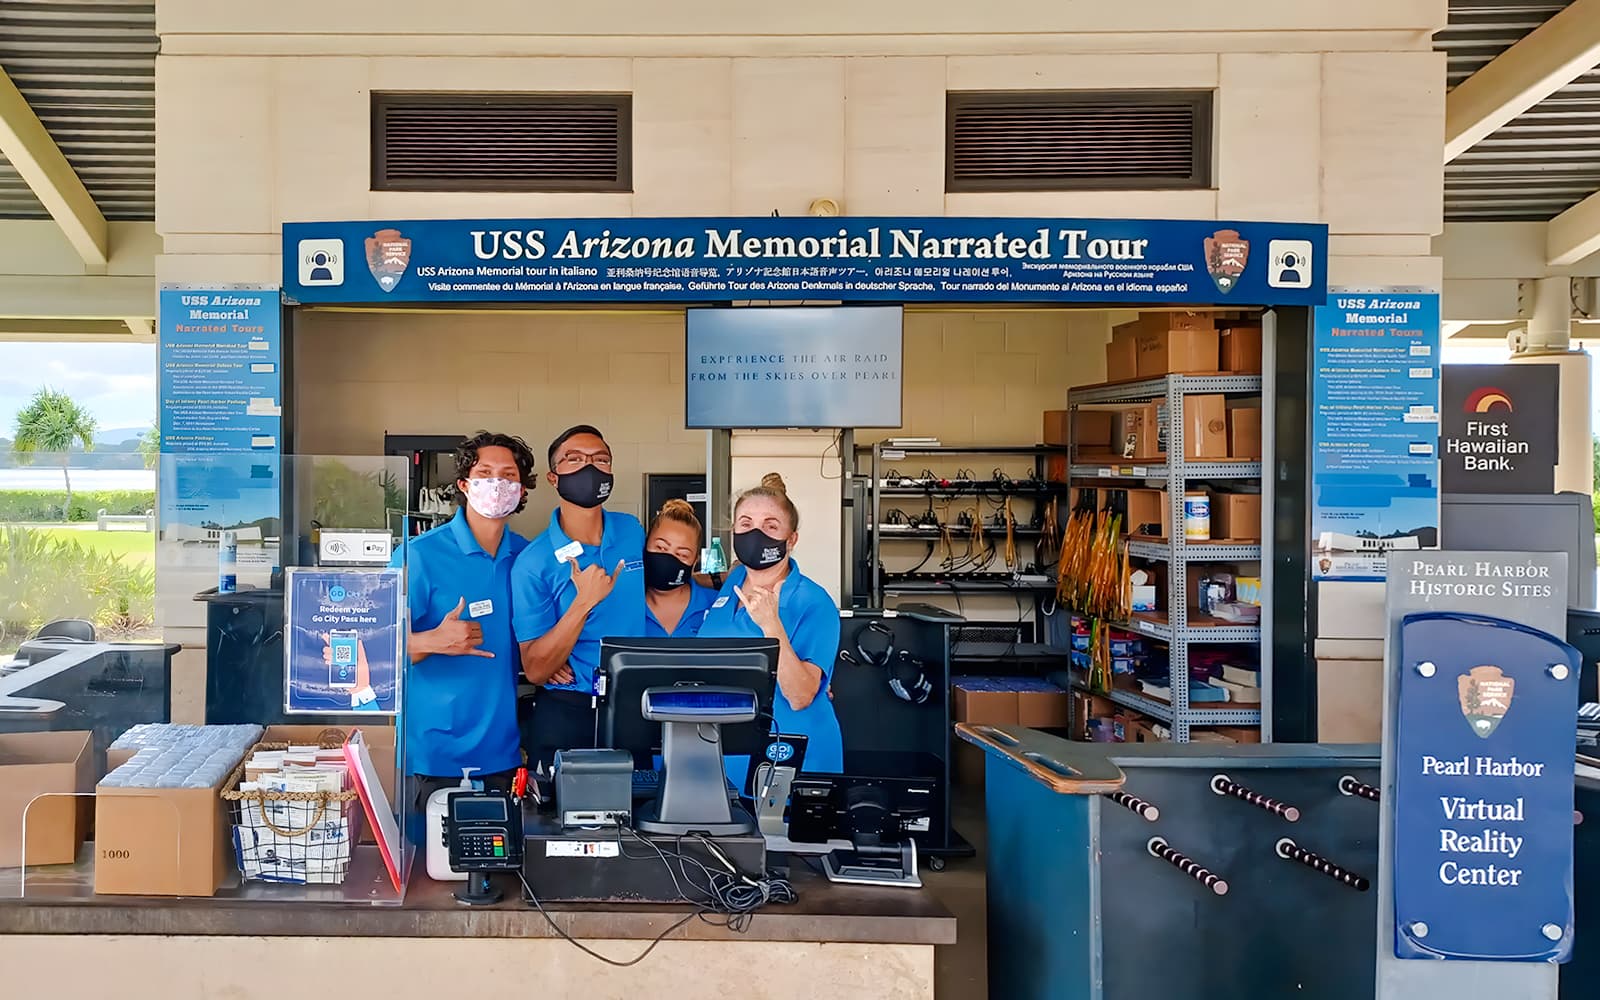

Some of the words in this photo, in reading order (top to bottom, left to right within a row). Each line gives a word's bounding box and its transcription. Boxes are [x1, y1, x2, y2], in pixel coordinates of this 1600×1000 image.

[470, 230, 546, 260] USS
[552, 230, 695, 260] Arizona
[704, 227, 882, 260] Memorial
[889, 228, 1051, 260] Narrated
[1059, 230, 1149, 260] Tour
[417, 267, 435, 276] USS
[438, 267, 474, 276] Arizona
[477, 266, 523, 276] Memorial
[526, 267, 548, 276] tour
[549, 266, 558, 276] in
[561, 266, 598, 276] italiano
[875, 267, 912, 277] 아리조나
[428, 282, 451, 291] Visite
[502, 282, 513, 291] du
[515, 282, 553, 291] Mémorial
[600, 283, 612, 291] en
[613, 281, 641, 292] langue
[688, 281, 726, 290] Geführte
[728, 281, 747, 290] Tour
[749, 281, 766, 290] des
[767, 281, 799, 290] Arizona
[801, 281, 844, 290] Denkmals
[845, 281, 853, 290] in
[855, 281, 897, 290] deutscher
[940, 281, 959, 291] Tour
[962, 282, 994, 291] narrado
[996, 282, 1009, 291] del
[1011, 282, 1060, 291] Monumento
[1061, 282, 1070, 291] al
[1071, 282, 1102, 291] Arizona
[1116, 282, 1124, 292] el
[1126, 282, 1153, 292] idioma
[1155, 283, 1188, 293] español
[181, 296, 208, 306] USS
[211, 296, 261, 306] Arizona
[1337, 299, 1366, 309] USS
[1368, 299, 1421, 309] Arizona
[189, 309, 249, 320] Memorial
[1345, 312, 1408, 323] Memorial
[176, 324, 227, 333] Narrated
[232, 324, 264, 333] Tours
[1331, 328, 1385, 336] Narrated
[701, 354, 785, 364] EXPERIENCE
[793, 354, 817, 363] THE
[824, 354, 847, 363] AIR
[854, 353, 888, 363] RAID
[691, 372, 727, 381] FROM
[735, 372, 759, 381] THE
[765, 372, 804, 381] SKIES
[811, 372, 847, 380] OVER
[855, 372, 897, 380] PEARL
[1467, 422, 1509, 437] First
[1447, 439, 1529, 454] Hawaiian
[1464, 456, 1515, 471] Bank.
[372, 544, 384, 553] Pay
[1412, 561, 1468, 576] PEARL
[1475, 562, 1549, 578] HARBOR
[1410, 580, 1496, 596] HISTORIC
[1502, 581, 1551, 597] SITES
[320, 605, 350, 613] Redeem
[352, 607, 370, 615] your
[312, 615, 323, 623] Go
[324, 615, 340, 624] City
[341, 615, 358, 623] Pass
[1422, 756, 1469, 775] Pearl
[1475, 757, 1544, 777] Harbor
[1440, 797, 1524, 821] Virtual
[1439, 829, 1523, 858] Reality
[103, 849, 130, 859] 1000
[1439, 862, 1522, 886] Center
